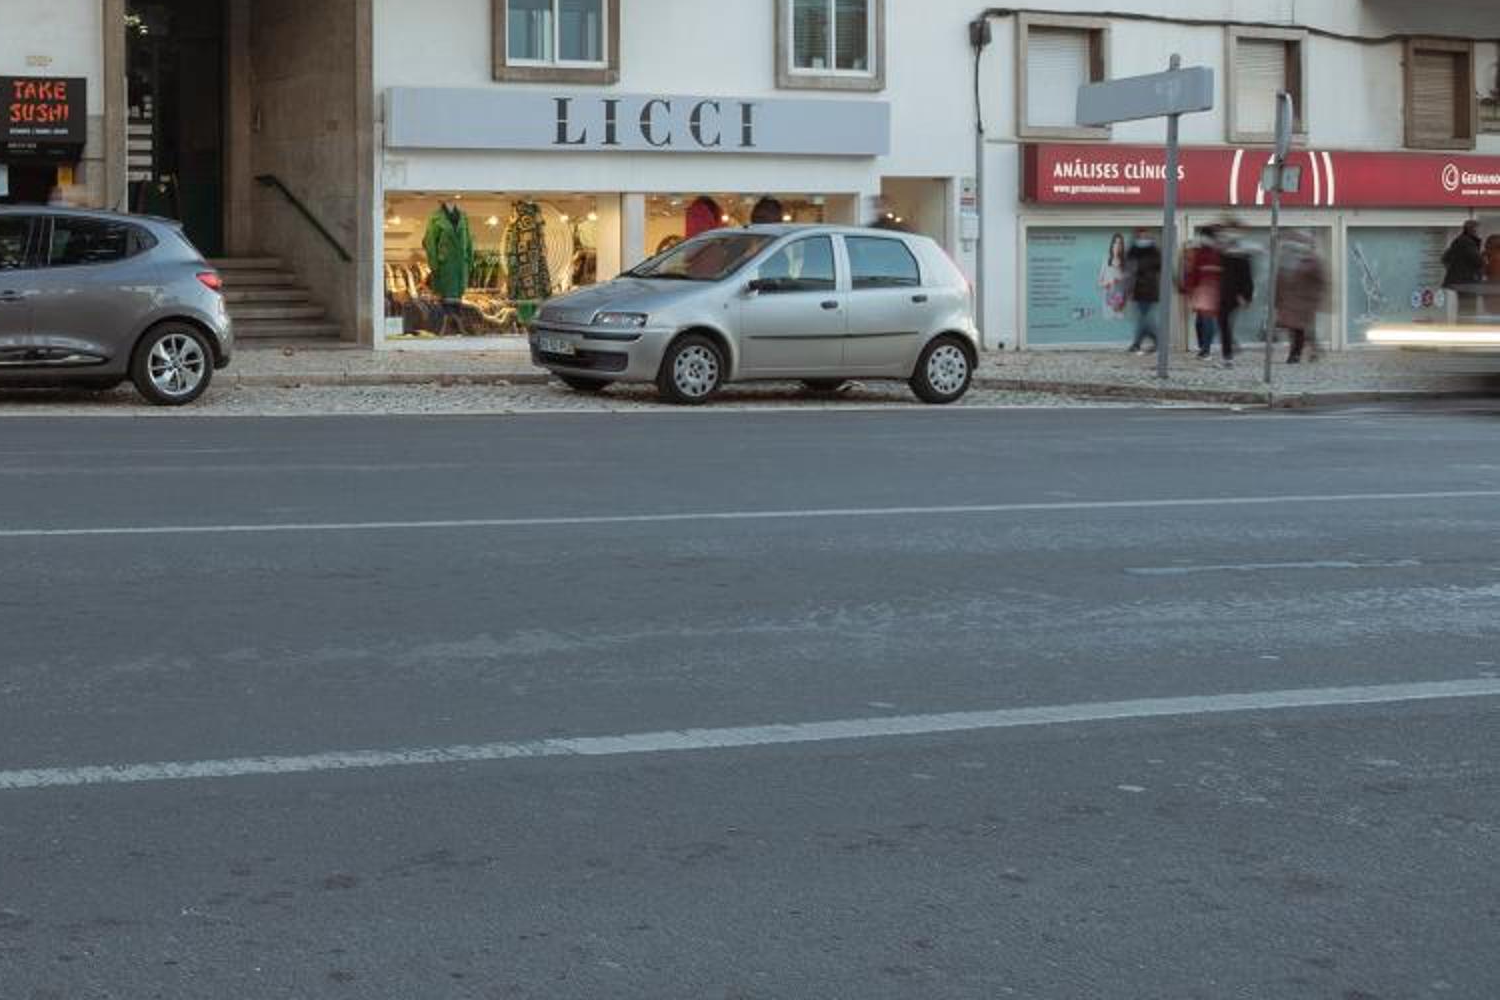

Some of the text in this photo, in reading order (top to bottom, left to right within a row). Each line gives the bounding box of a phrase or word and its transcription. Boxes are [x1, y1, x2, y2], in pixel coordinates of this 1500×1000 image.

[13, 81, 66, 100] TAKE
[9, 103, 68, 122] SUSHI
[552, 97, 758, 147] LICCI
[1053, 158, 1185, 180] ANÁLISES CLÍNICS
